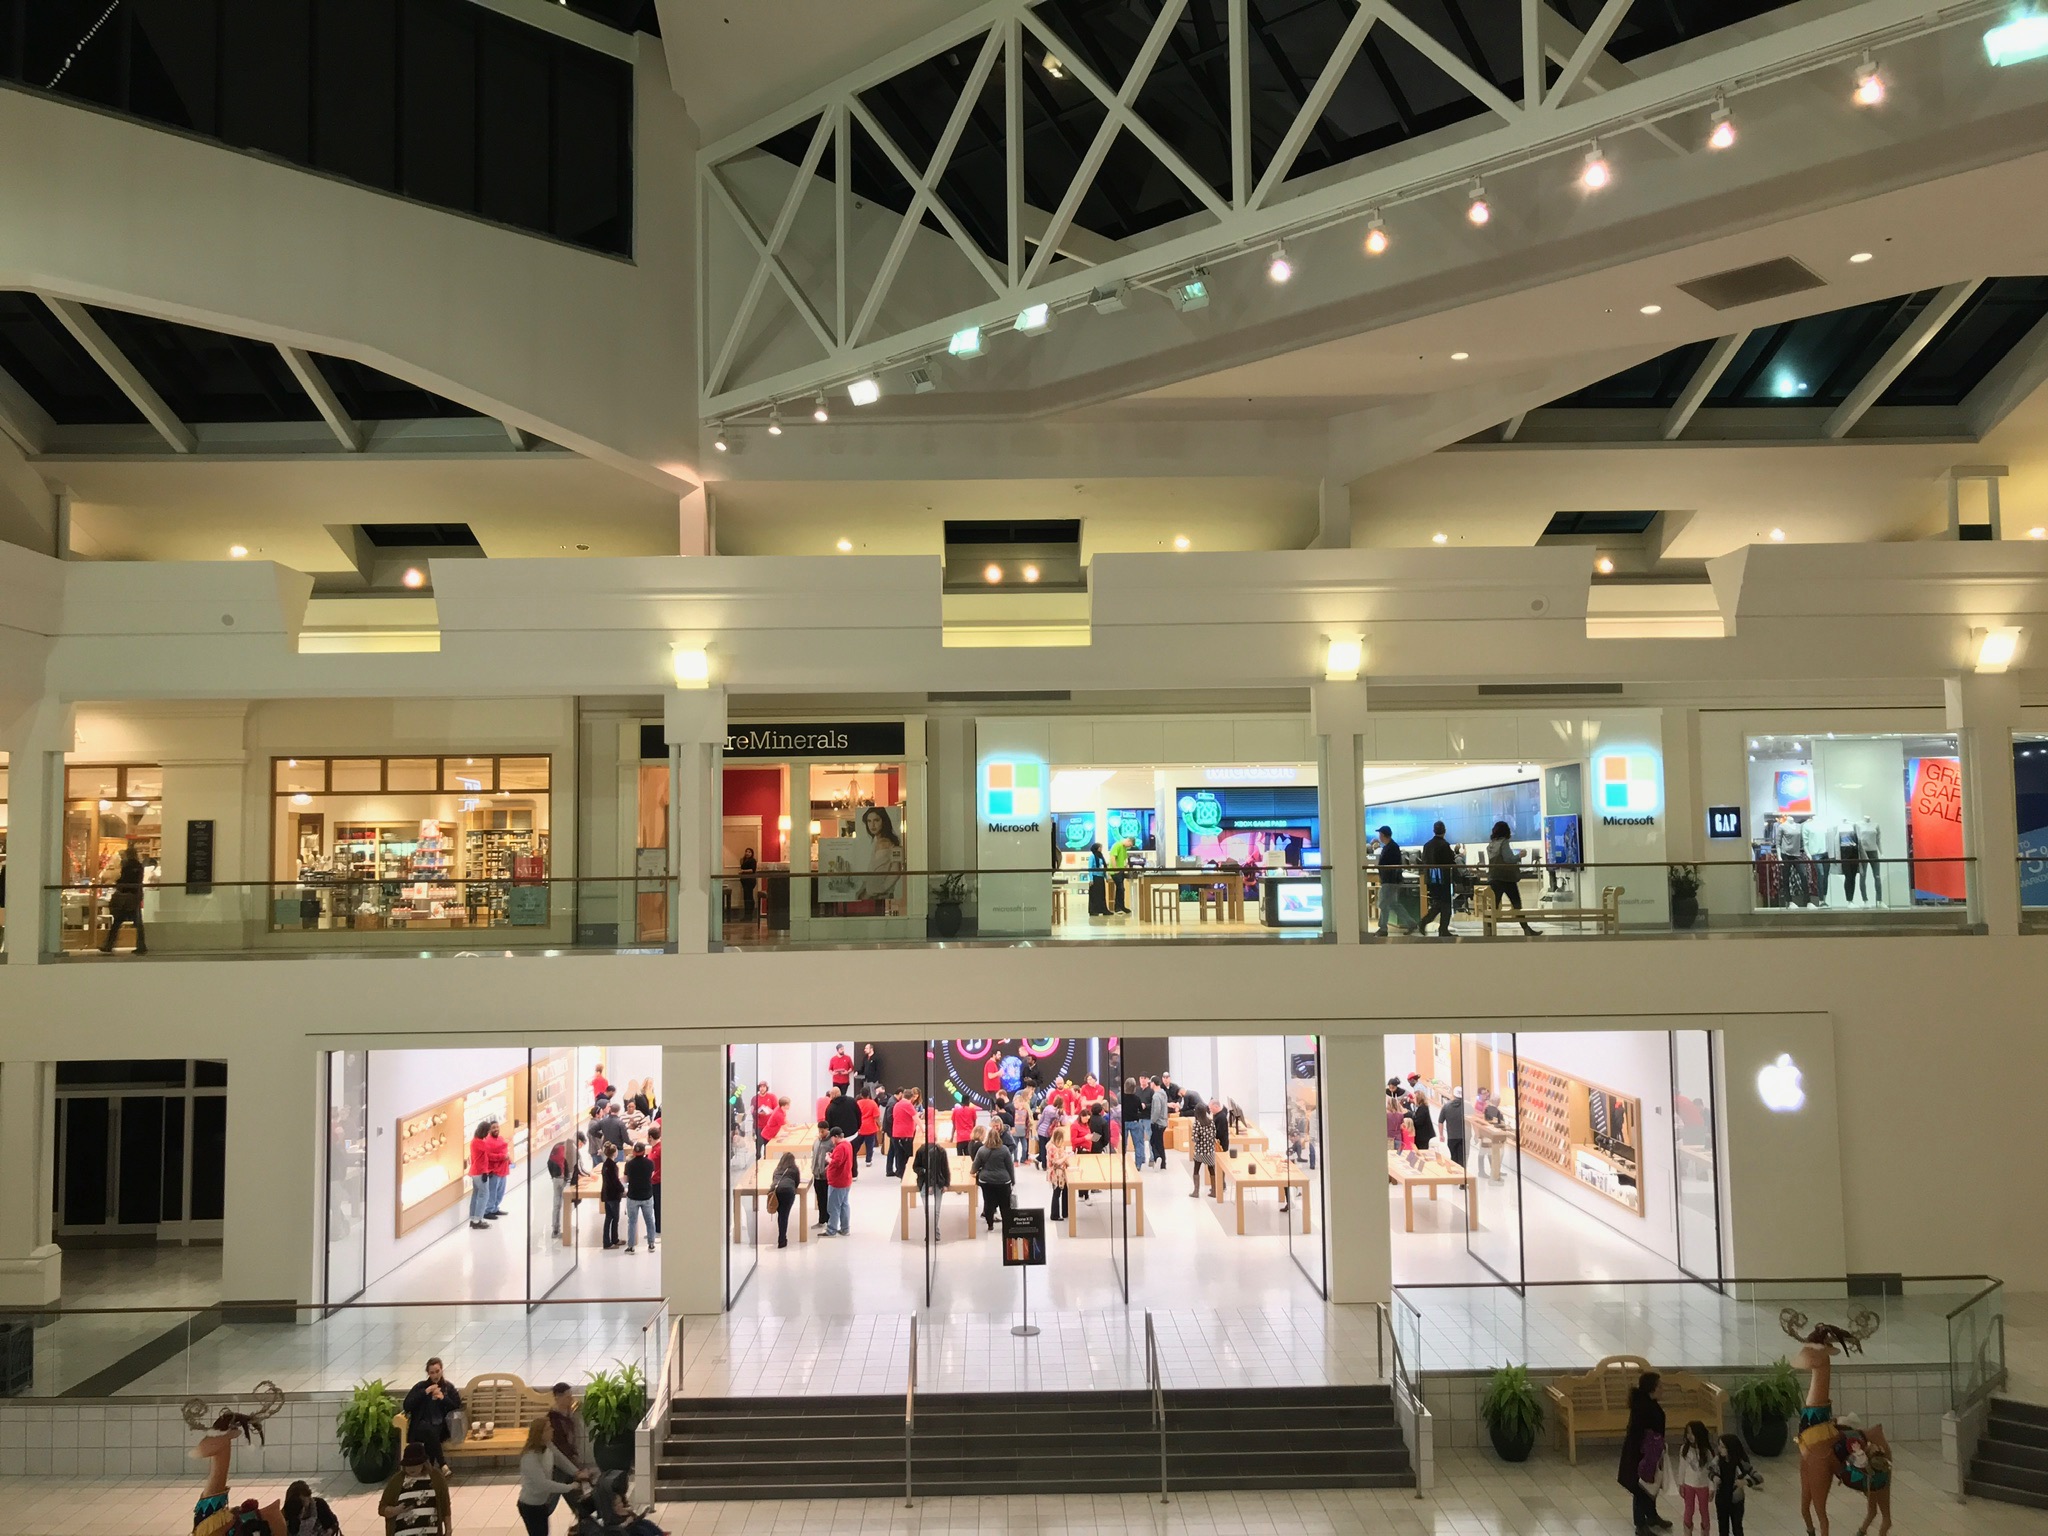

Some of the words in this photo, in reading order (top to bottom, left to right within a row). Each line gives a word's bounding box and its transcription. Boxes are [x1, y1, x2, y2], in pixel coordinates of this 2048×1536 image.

[723, 730, 849, 750] reMinerals
[1926, 764, 1961, 787] GRE
[1233, 820, 1253, 828] XBOX
[1603, 815, 1655, 826] Microsoft
[1714, 813, 1737, 832] GAP
[988, 822, 1040, 833] Microsoft
[517, 865, 541, 875] SALE
